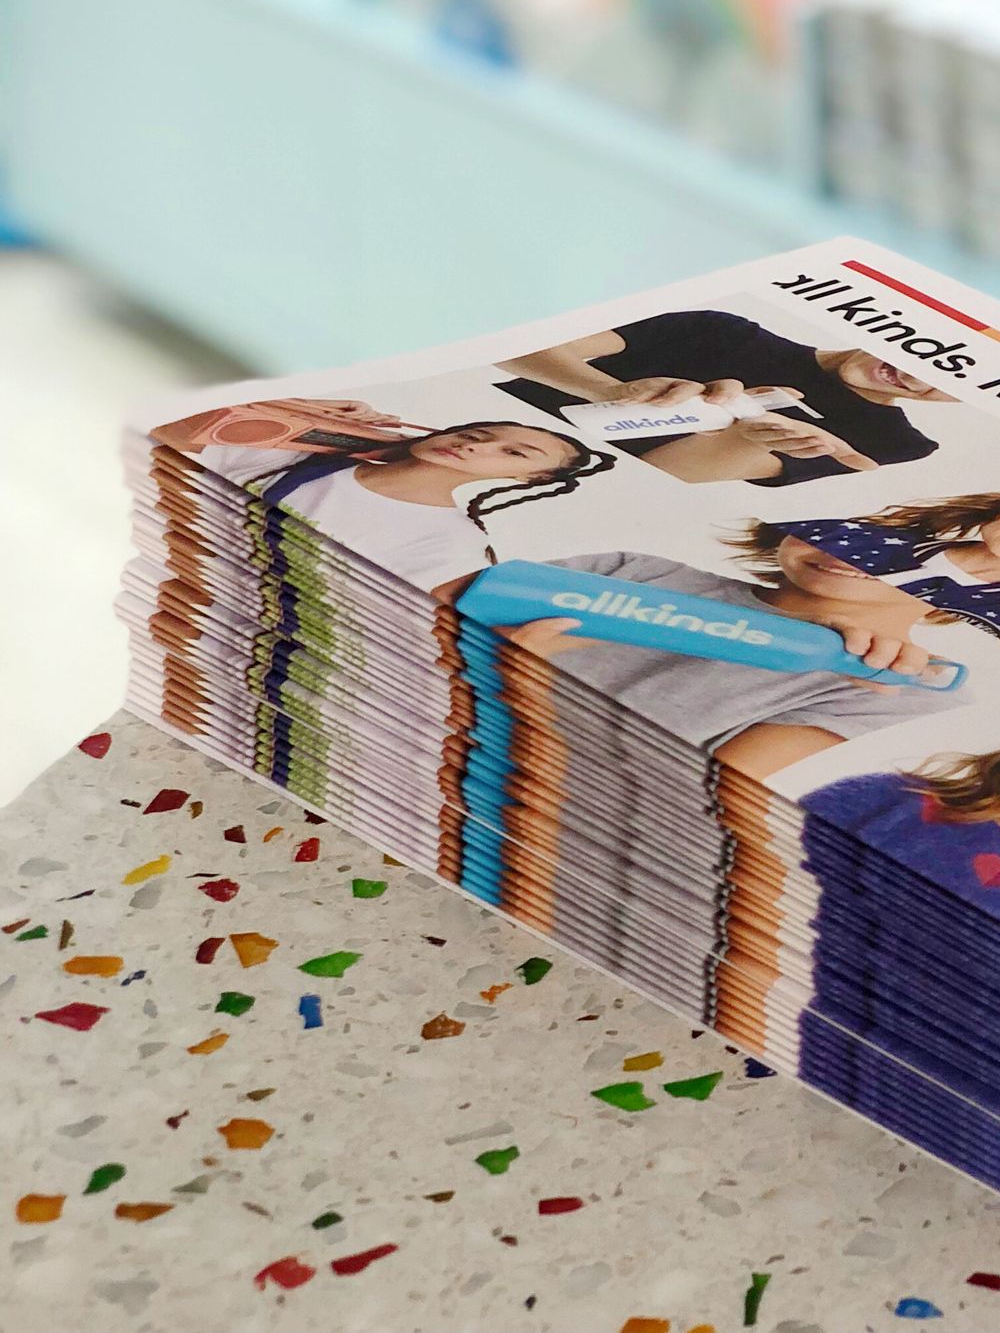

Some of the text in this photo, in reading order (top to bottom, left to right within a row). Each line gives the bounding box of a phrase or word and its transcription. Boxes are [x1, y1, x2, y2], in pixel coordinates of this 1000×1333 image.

[826, 295, 977, 379] kinds.
[603, 414, 701, 433] allkinds
[551, 591, 774, 646] allkinds
